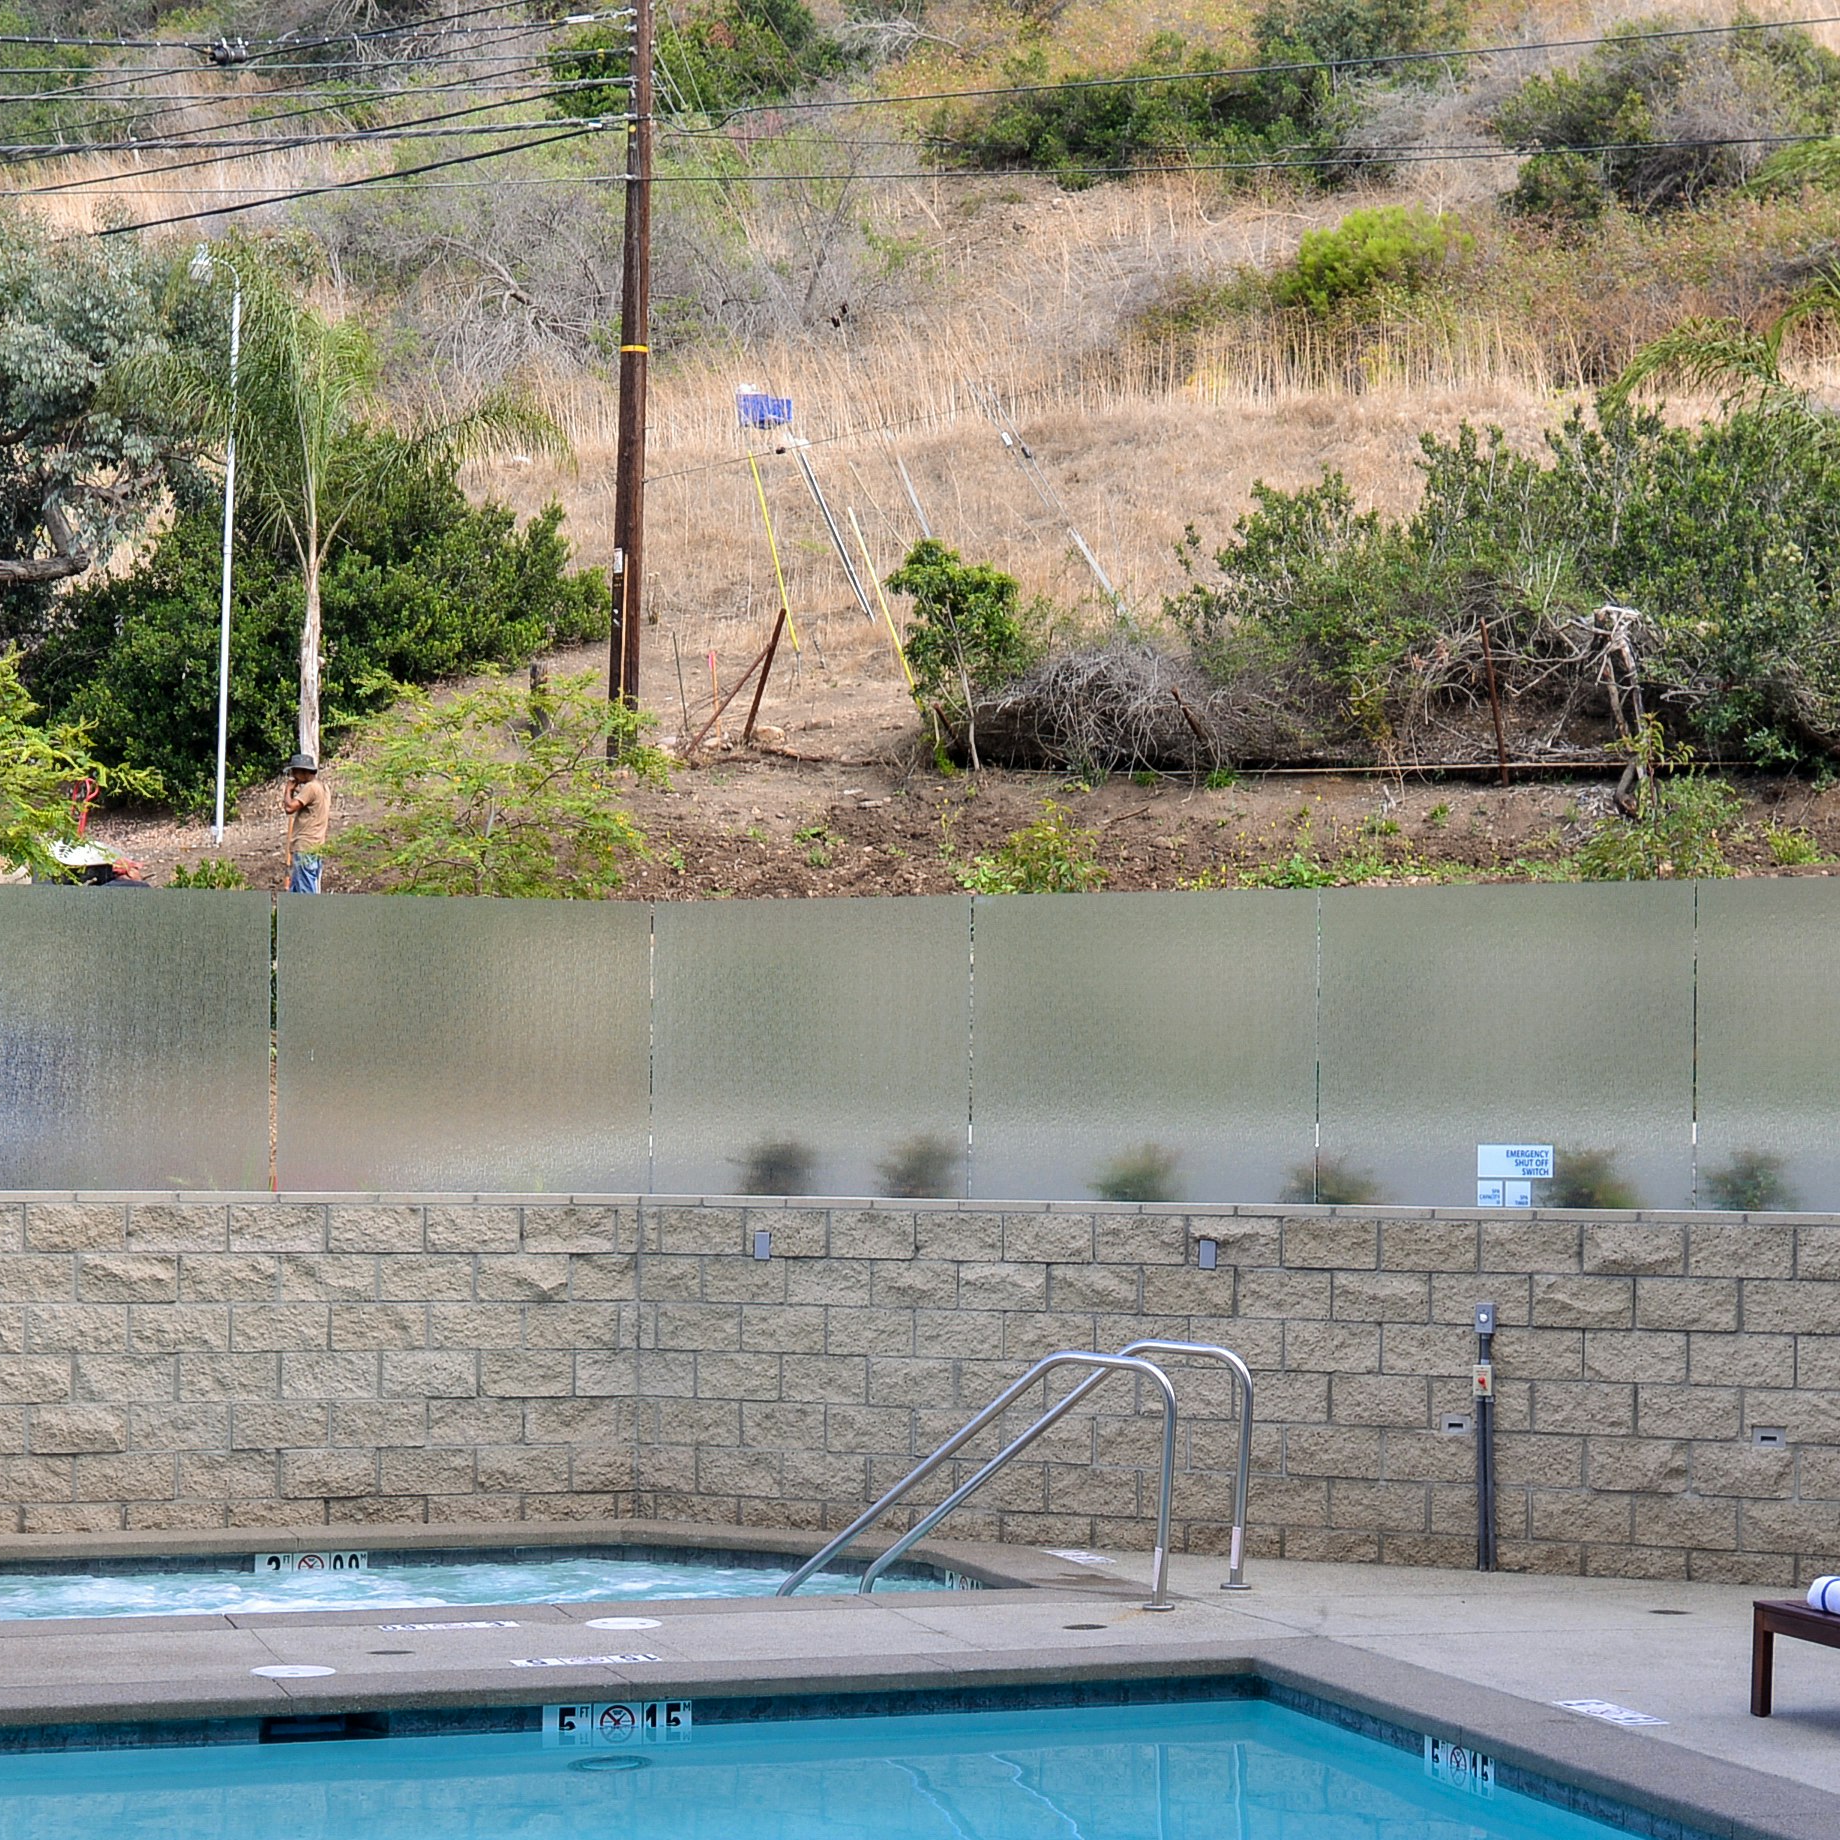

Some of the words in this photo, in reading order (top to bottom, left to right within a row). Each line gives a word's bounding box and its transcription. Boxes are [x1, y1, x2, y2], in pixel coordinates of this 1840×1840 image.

[1506, 1149, 1549, 1158] EMERGENCY
[1514, 1159, 1533, 1167] SHUT
[1535, 1159, 1549, 1167] OFF
[1522, 1168, 1549, 1176] SWITCH
[559, 1707, 576, 1731] 5
[580, 1706, 589, 1718] FT
[683, 1700, 691, 1711] M
